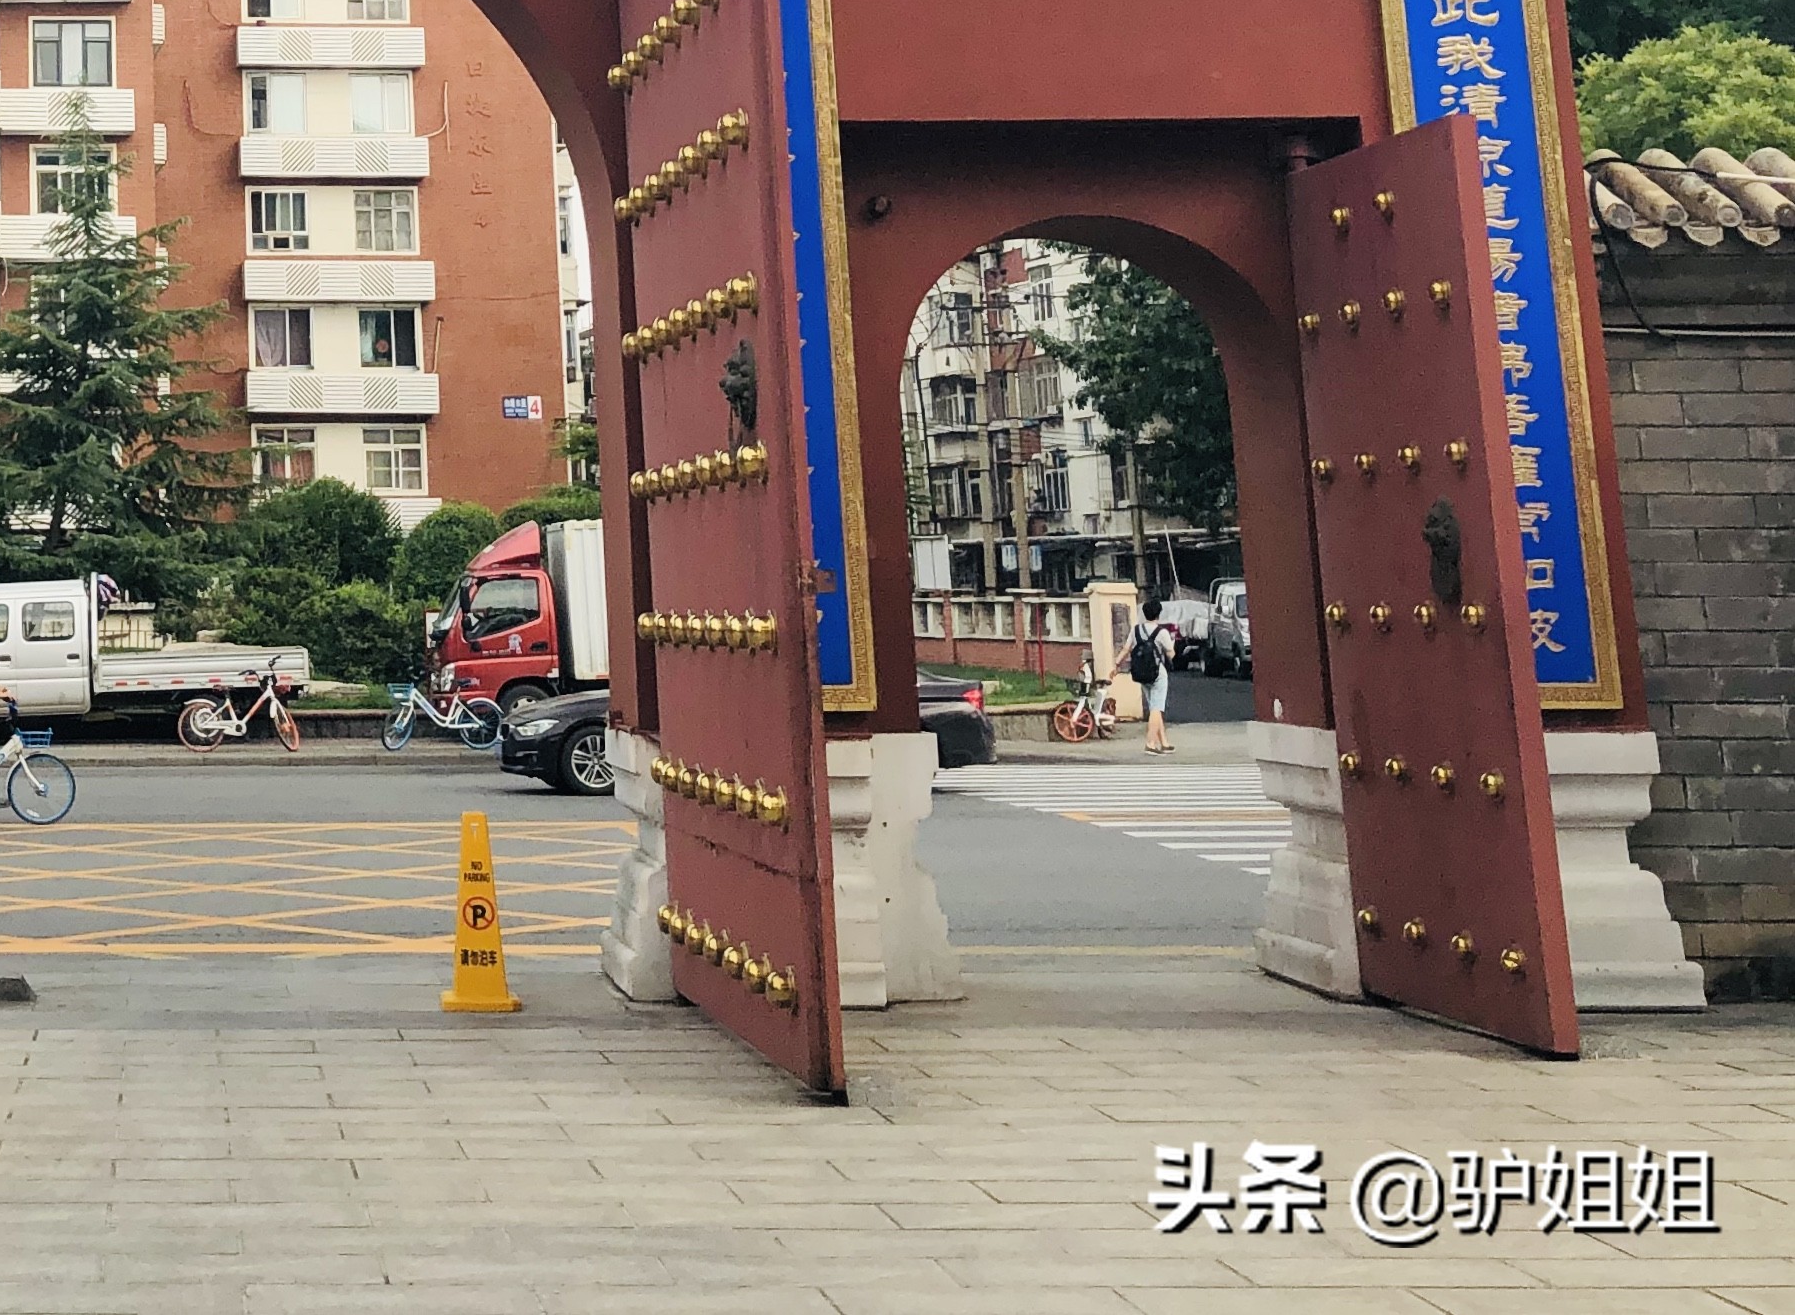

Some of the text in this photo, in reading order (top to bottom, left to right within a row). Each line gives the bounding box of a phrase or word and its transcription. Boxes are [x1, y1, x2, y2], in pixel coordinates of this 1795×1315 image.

[530, 399, 540, 416] 4
[471, 861, 483, 870] NO
[463, 873, 490, 883] PARKING
[460, 948, 498, 967] 请勿泊车
